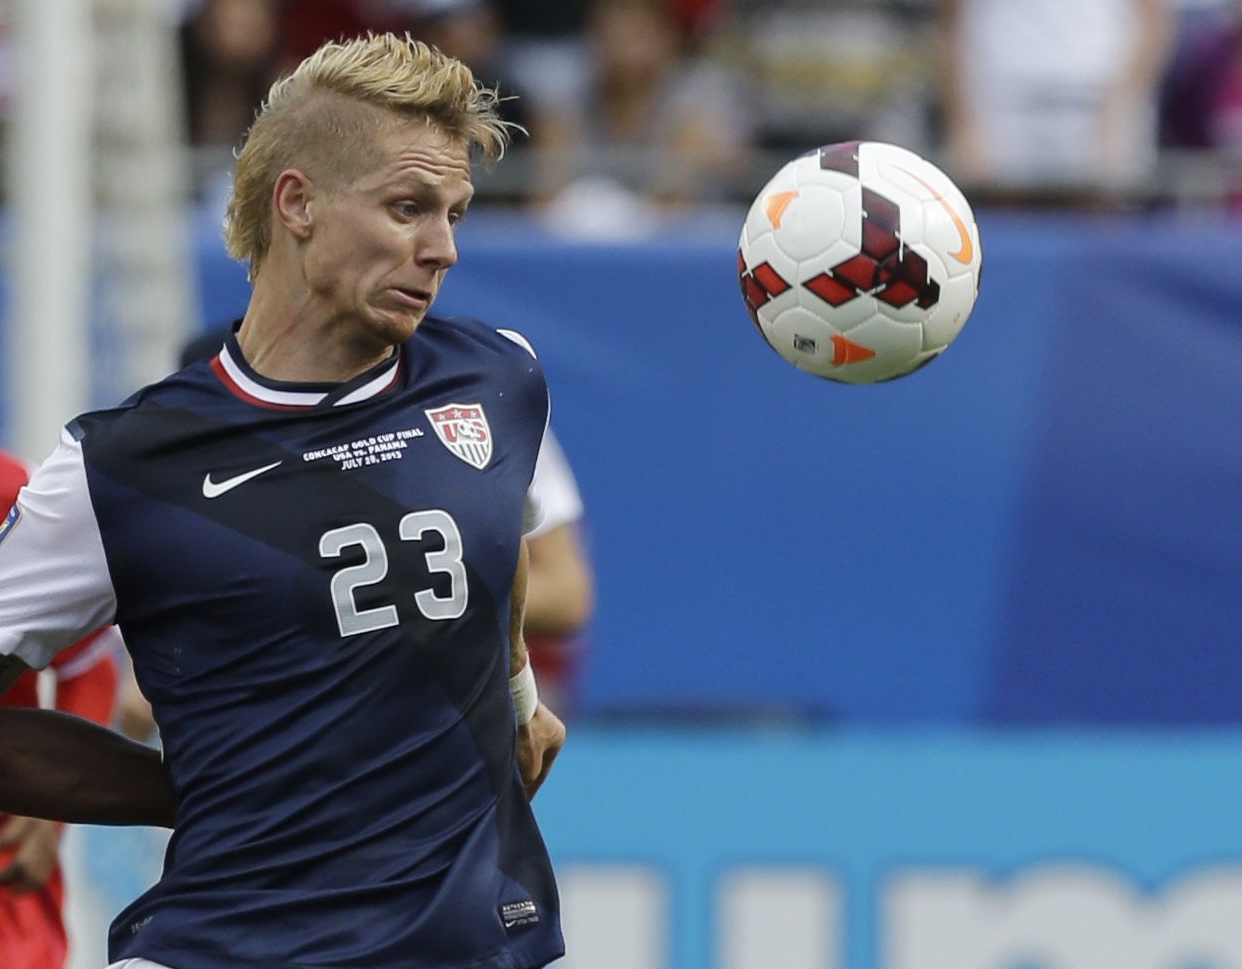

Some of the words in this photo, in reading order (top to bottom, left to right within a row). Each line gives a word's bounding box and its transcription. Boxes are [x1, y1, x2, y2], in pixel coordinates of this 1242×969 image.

[302, 443, 349, 462] CONCACAF
[351, 438, 376, 450] GOLD
[376, 433, 395, 443] CUP
[396, 428, 424, 440] FINAL
[332, 450, 353, 462] USA
[368, 440, 408, 454] PANAMA
[341, 457, 363, 471] JULY
[380, 450, 403, 462] 2013
[318, 509, 469, 637] 23
